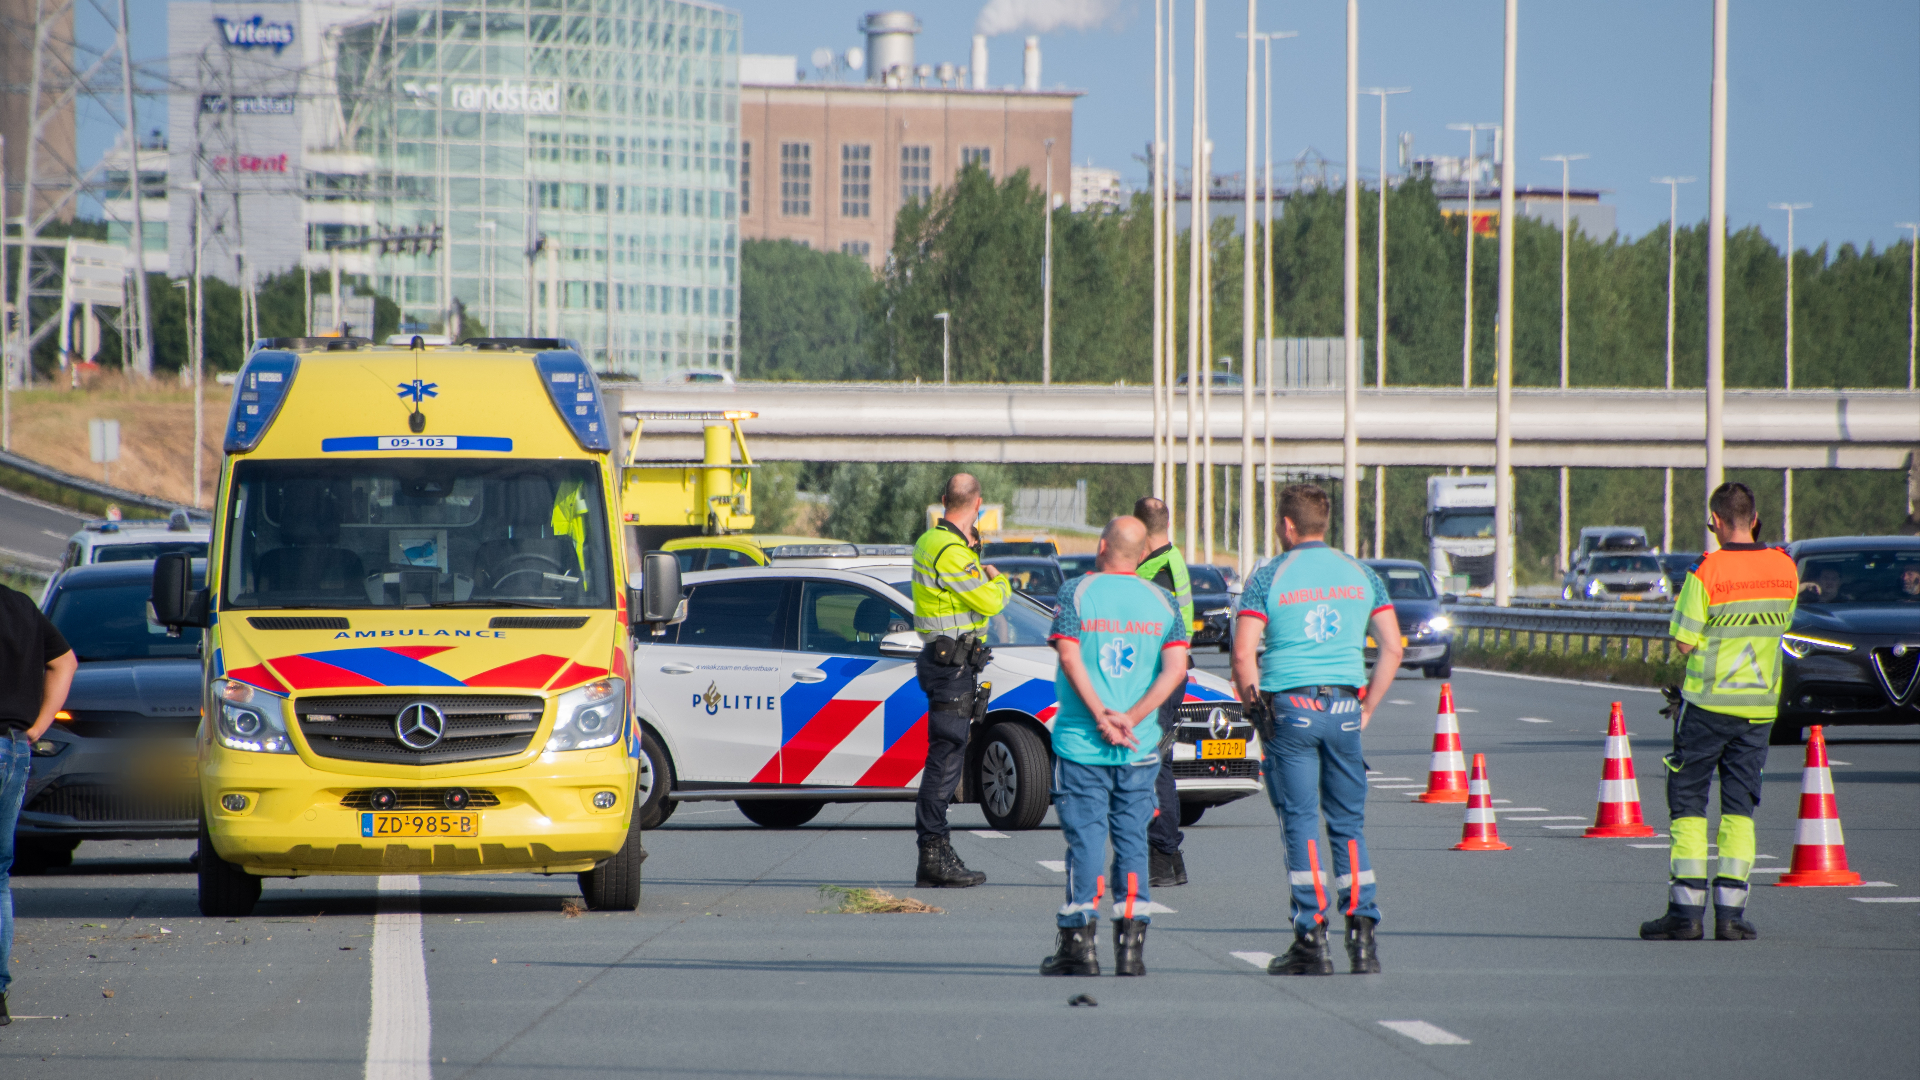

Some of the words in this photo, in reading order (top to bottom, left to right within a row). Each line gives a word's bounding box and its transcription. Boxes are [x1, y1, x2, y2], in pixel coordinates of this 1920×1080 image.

[222, 23, 292, 45] Vitens
[451, 77, 561, 112] randstad
[390, 438, 444, 448] 09-103
[1715, 580, 1793, 594] Rijkswaterstaat
[1278, 585, 1365, 607] AMBULANCE
[333, 629, 507, 640] AMBULANCE
[1079, 619, 1163, 637] AMBULANCE
[742, 664, 774, 672] dienstbaar
[692, 693, 775, 715] POLITIE
[1207, 742, 1243, 756] Z-372-PJ
